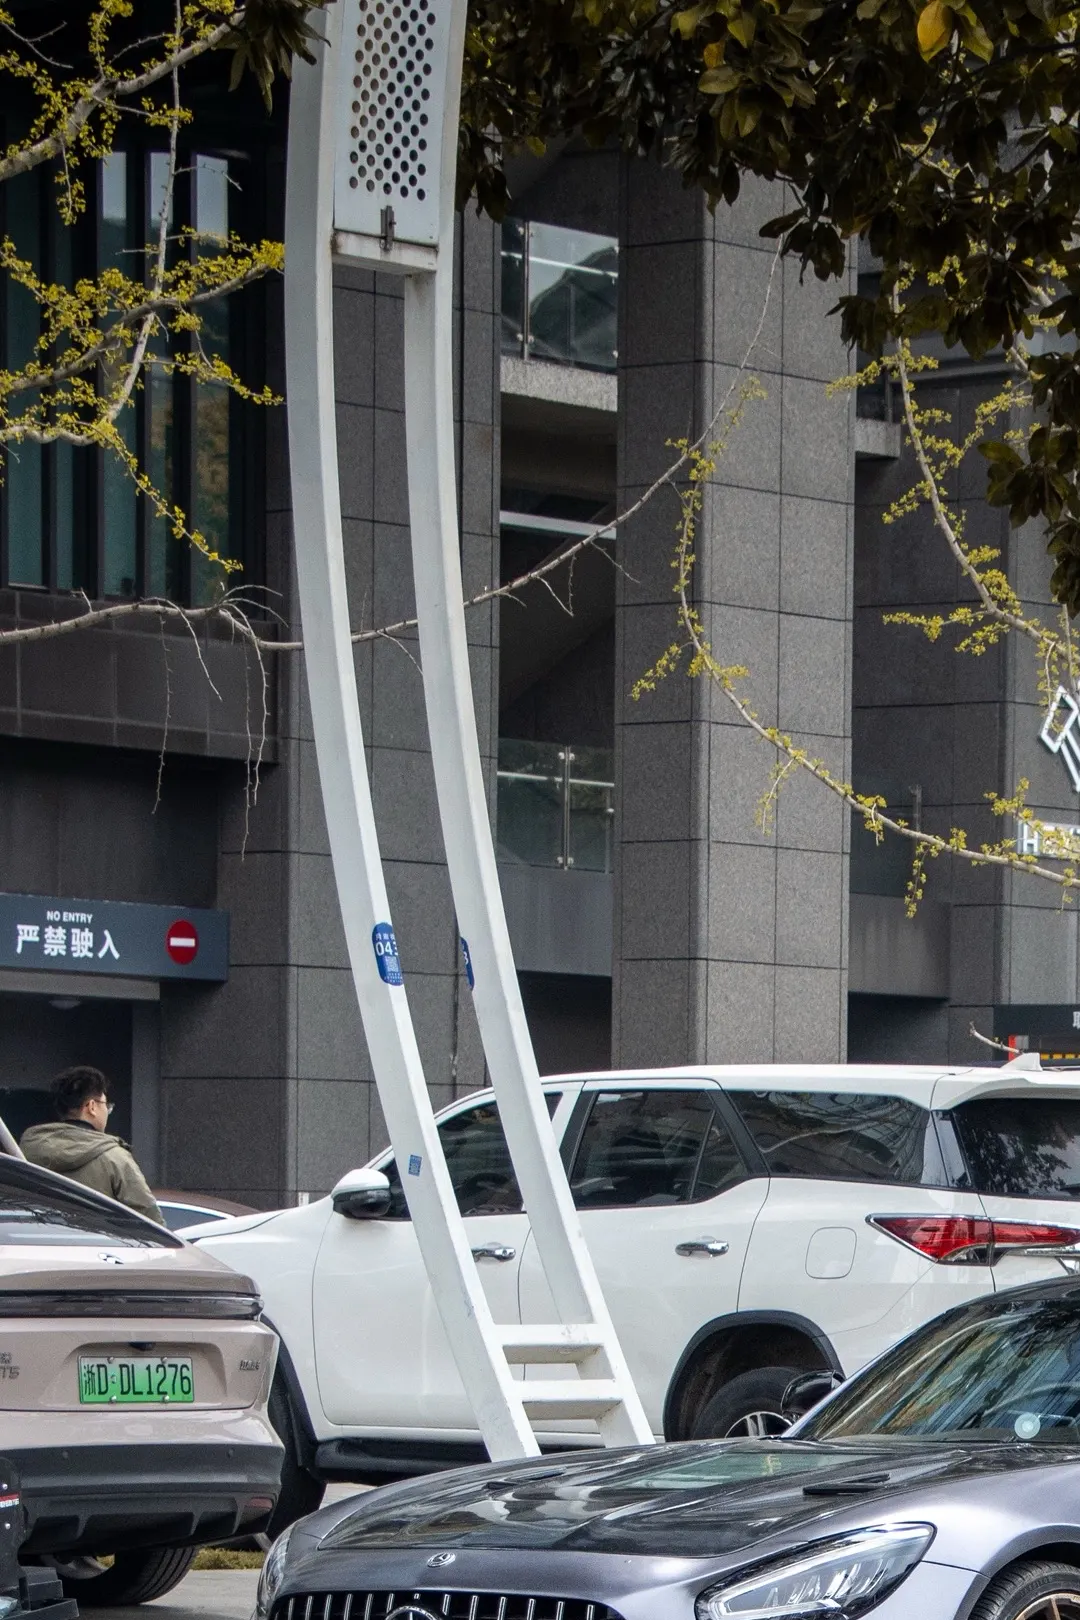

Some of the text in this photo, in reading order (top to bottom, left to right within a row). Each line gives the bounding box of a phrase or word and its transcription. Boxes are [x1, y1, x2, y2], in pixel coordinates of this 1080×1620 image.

[46, 910, 93, 924] NO ENTRY
[15, 923, 121, 960] 严禁驶入
